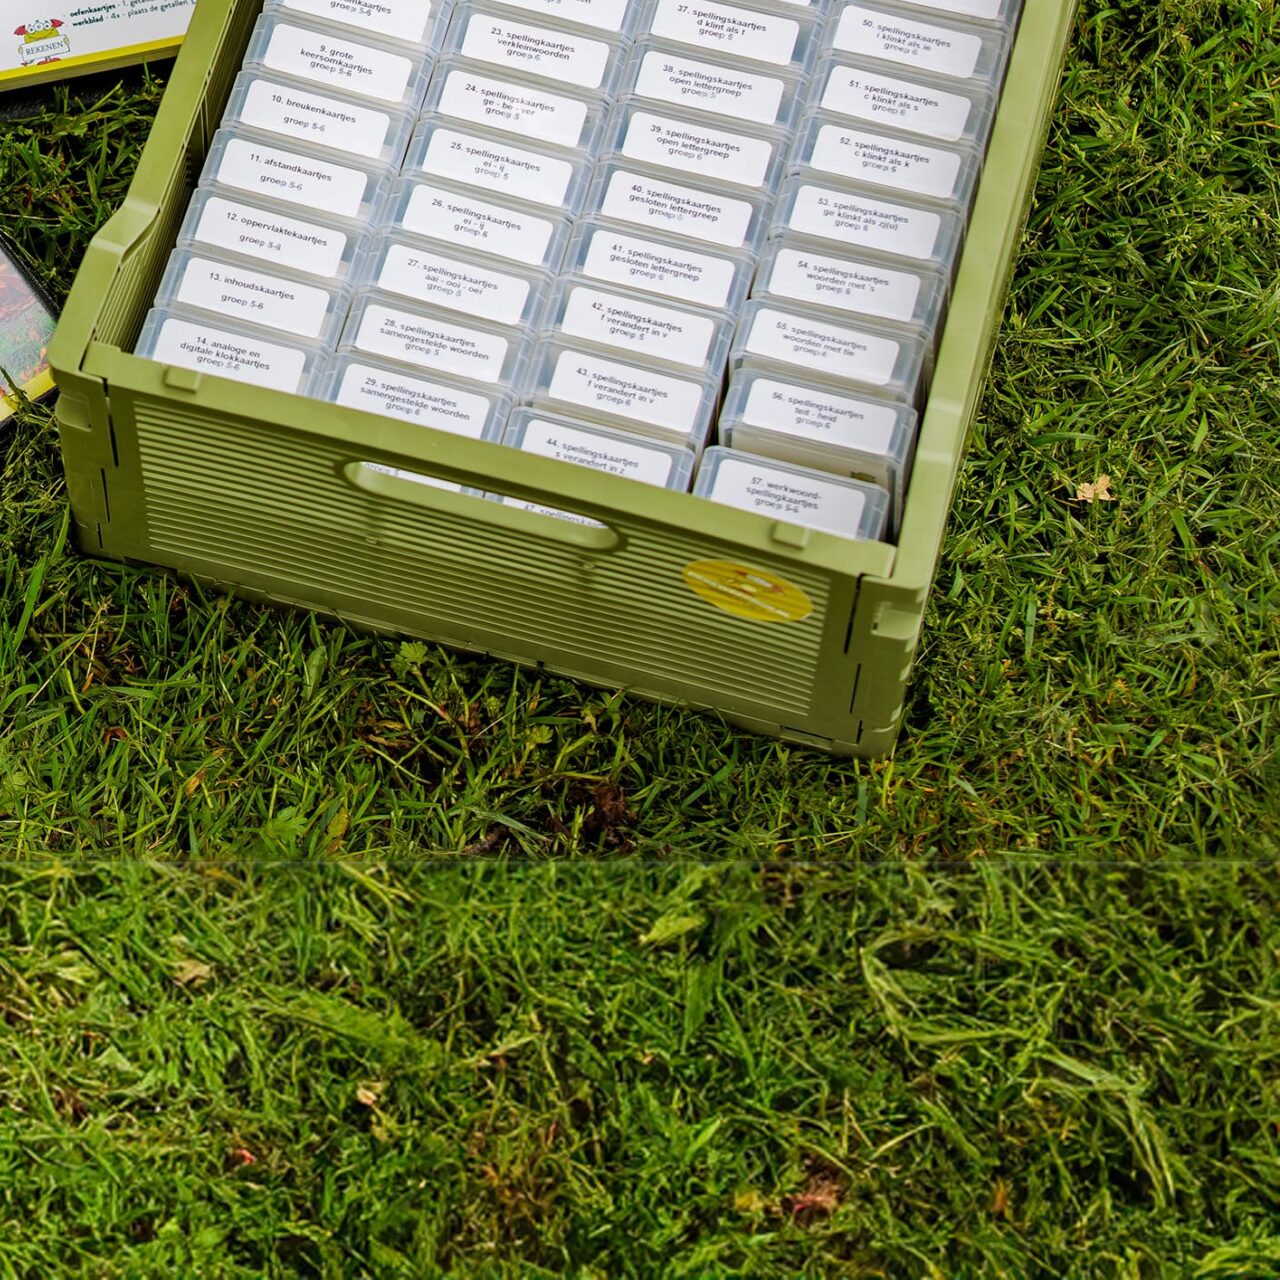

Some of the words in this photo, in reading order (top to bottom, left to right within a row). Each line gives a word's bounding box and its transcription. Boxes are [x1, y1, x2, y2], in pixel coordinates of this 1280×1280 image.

[69, 2, 116, 17] oefenkaartjes
[71, 14, 104, 27] werkblad
[127, 7, 148, 18] plaats
[148, 4, 158, 12] de
[159, 0, 188, 12] getallen
[25, 41, 64, 55] REKENEN
[299, 48, 372, 74] keersomkaartjes
[328, 49, 353, 60] grote
[662, 64, 675, 73] 38.
[677, 69, 752, 90] spellingskaartjes
[668, 75, 691, 89] open
[692, 80, 741, 98] lettergreep
[848, 79, 861, 88] 51.
[863, 84, 938, 107] spellingskaartjes
[272, 94, 283, 104] 10.
[285, 97, 356, 123] breukenkaartjes
[248, 153, 261, 163] 11.
[263, 158, 331, 181] afstandkaartjes
[226, 211, 238, 223] 12.
[240, 217, 327, 246] oppervlaktekaartjes
[610, 243, 624, 253] 41.
[626, 249, 702, 273] spellingskaartjes
[209, 272, 221, 281] 13.
[223, 275, 294, 300] inhoudskaartjes
[179, 342, 213, 359] digitale
[213, 349, 270, 370] klokkaartjes
[196, 336, 208, 345] 14.
[210, 340, 247, 355] analoge
[248, 350, 260, 358] en
[379, 327, 448, 351] samengestelde
[449, 345, 489, 360] woorden
